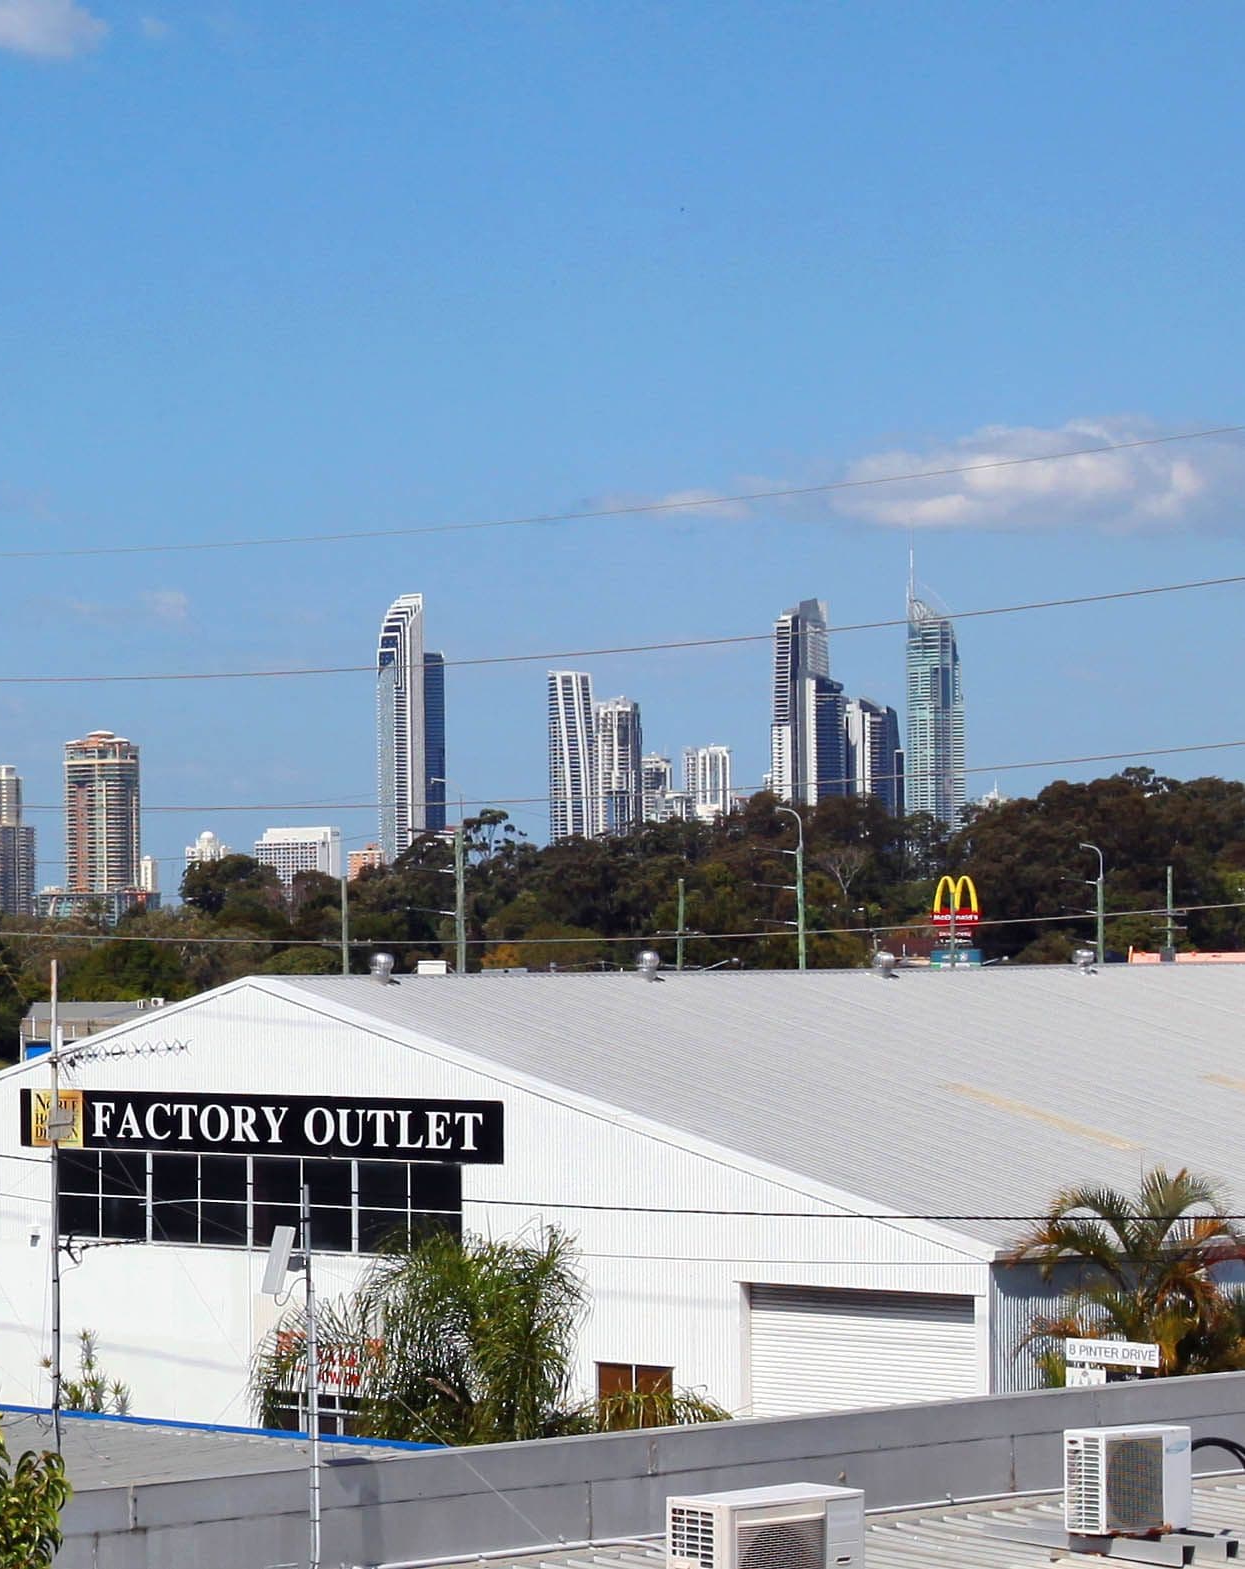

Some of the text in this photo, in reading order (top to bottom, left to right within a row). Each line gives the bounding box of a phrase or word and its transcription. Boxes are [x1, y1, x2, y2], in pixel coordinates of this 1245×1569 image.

[91, 1101, 483, 1151] FACTORY OUTLET
[1079, 1344, 1119, 1360] PINTER
[1121, 1347, 1156, 1361] DRIVE
